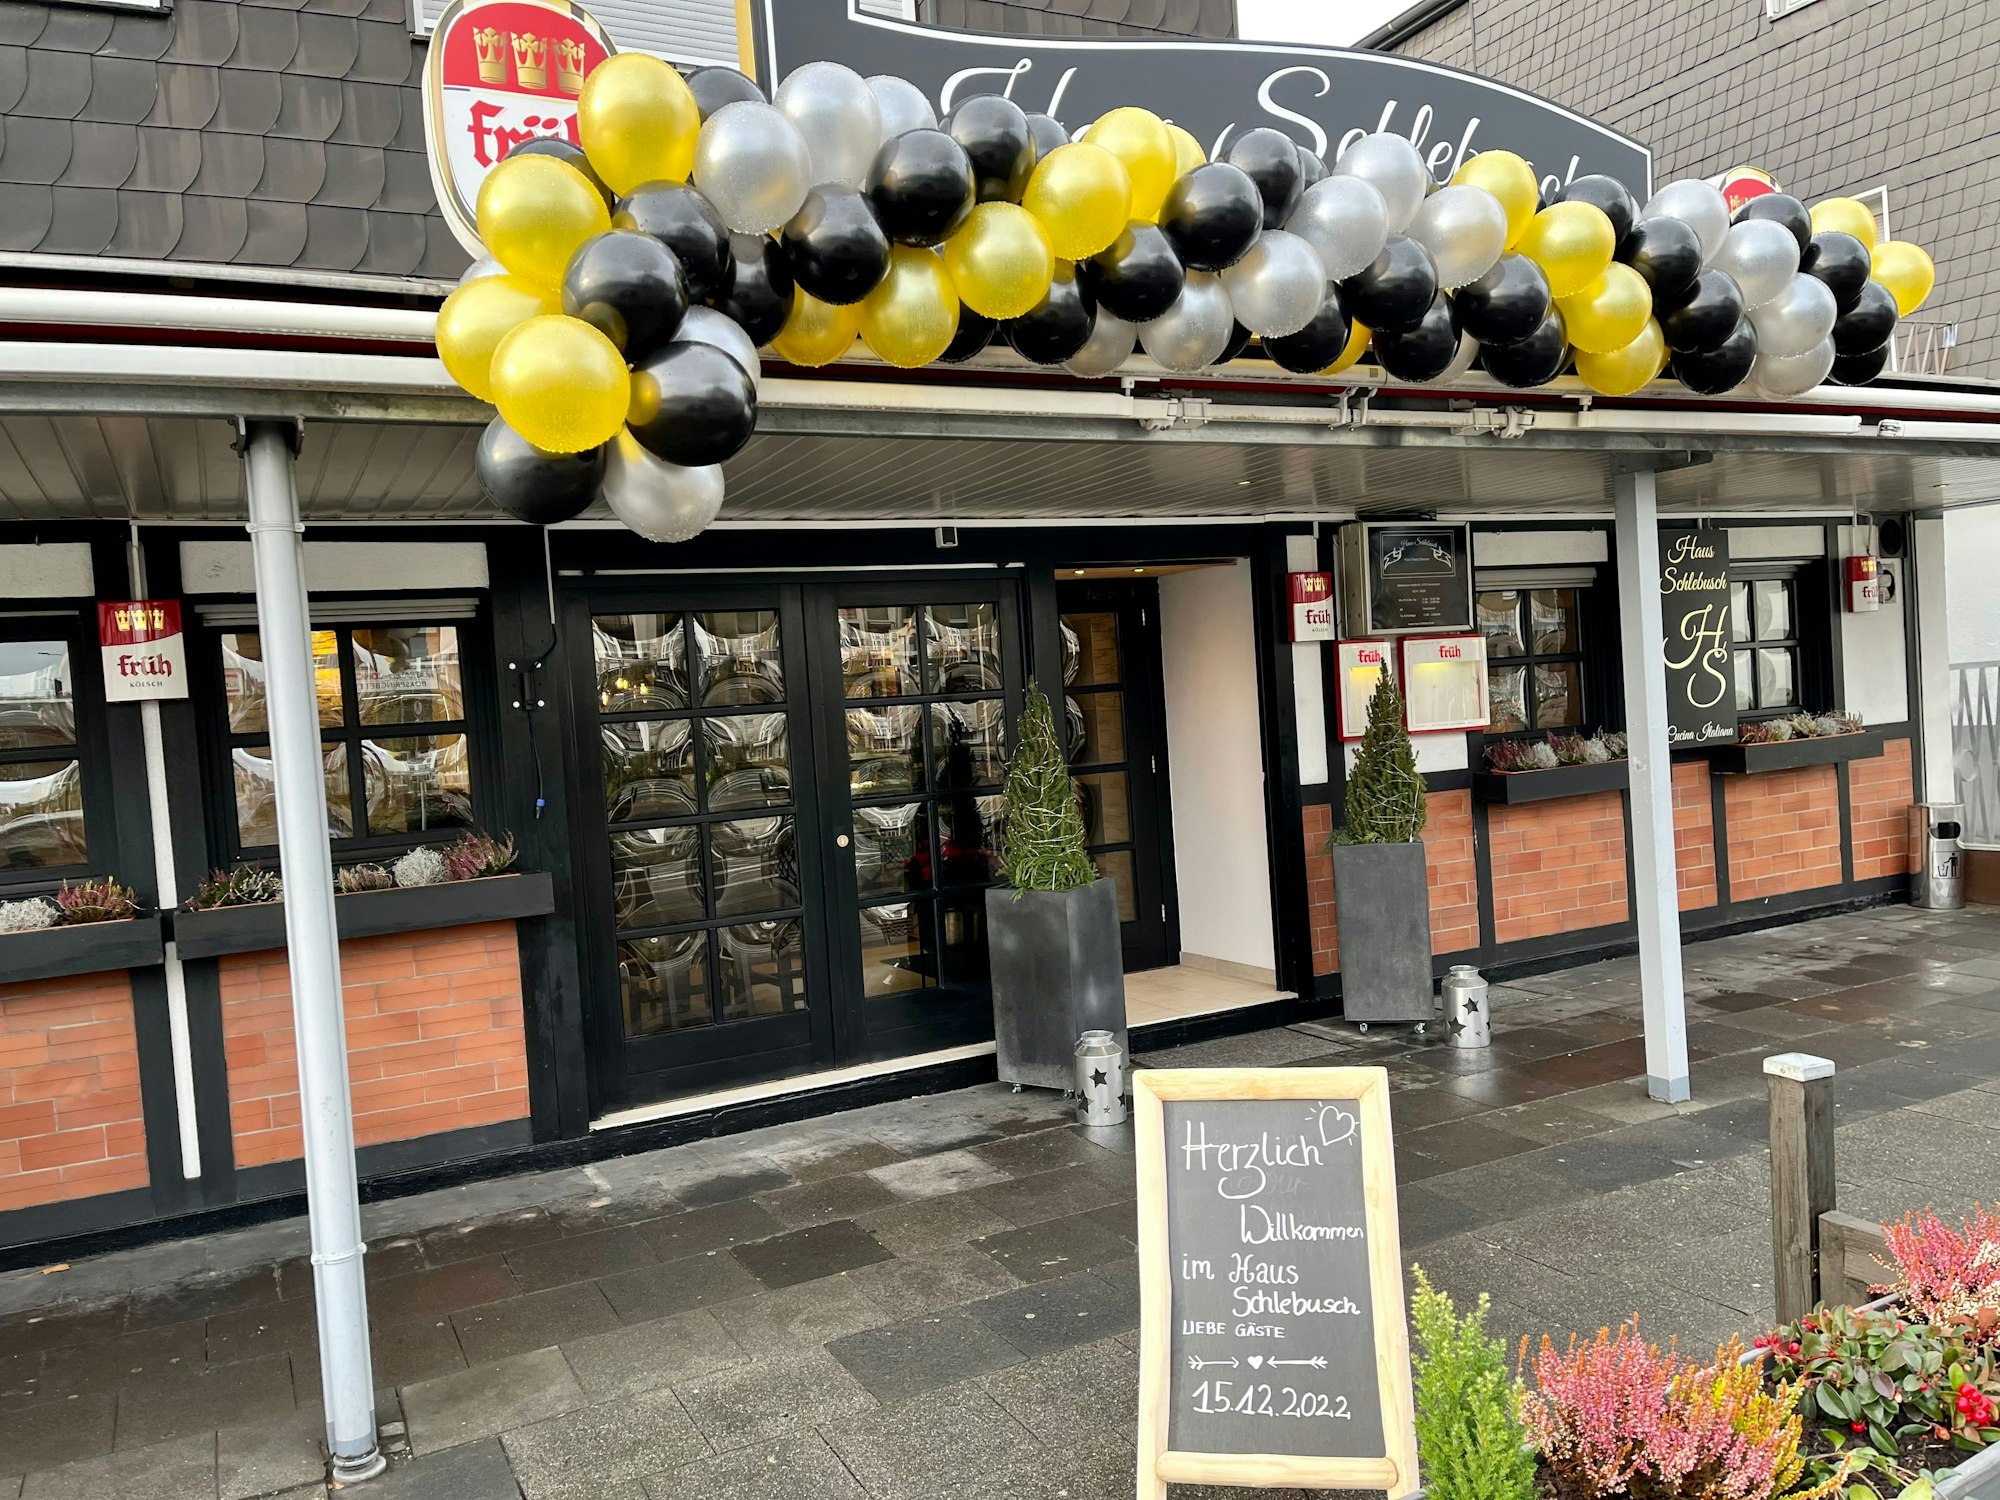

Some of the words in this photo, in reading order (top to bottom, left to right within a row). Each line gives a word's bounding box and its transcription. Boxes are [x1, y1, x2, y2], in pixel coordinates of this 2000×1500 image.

[1667, 535, 1715, 563] Haus
[1660, 567, 1728, 594] Schlebusch
[1305, 609, 1331, 625] früh
[1358, 649, 1381, 663] früh
[1439, 645, 1461, 659] früh
[117, 653, 172, 677] früh
[130, 680, 163, 688] KÖLSCH
[1667, 725, 1694, 743] Cucina
[1696, 721, 1734, 741] Italiana
[1180, 1120, 1324, 1199] Herzlich
[1241, 1204, 1364, 1244] Willkommen
[1182, 1253, 1215, 1280] im
[1228, 1252, 1300, 1285] Haus
[1231, 1286, 1361, 1317] Schlebusch
[1182, 1319, 1226, 1335] LIEBE
[1235, 1322, 1286, 1339] GÄSTE
[1192, 1380, 1352, 1420] 15.12.2022
